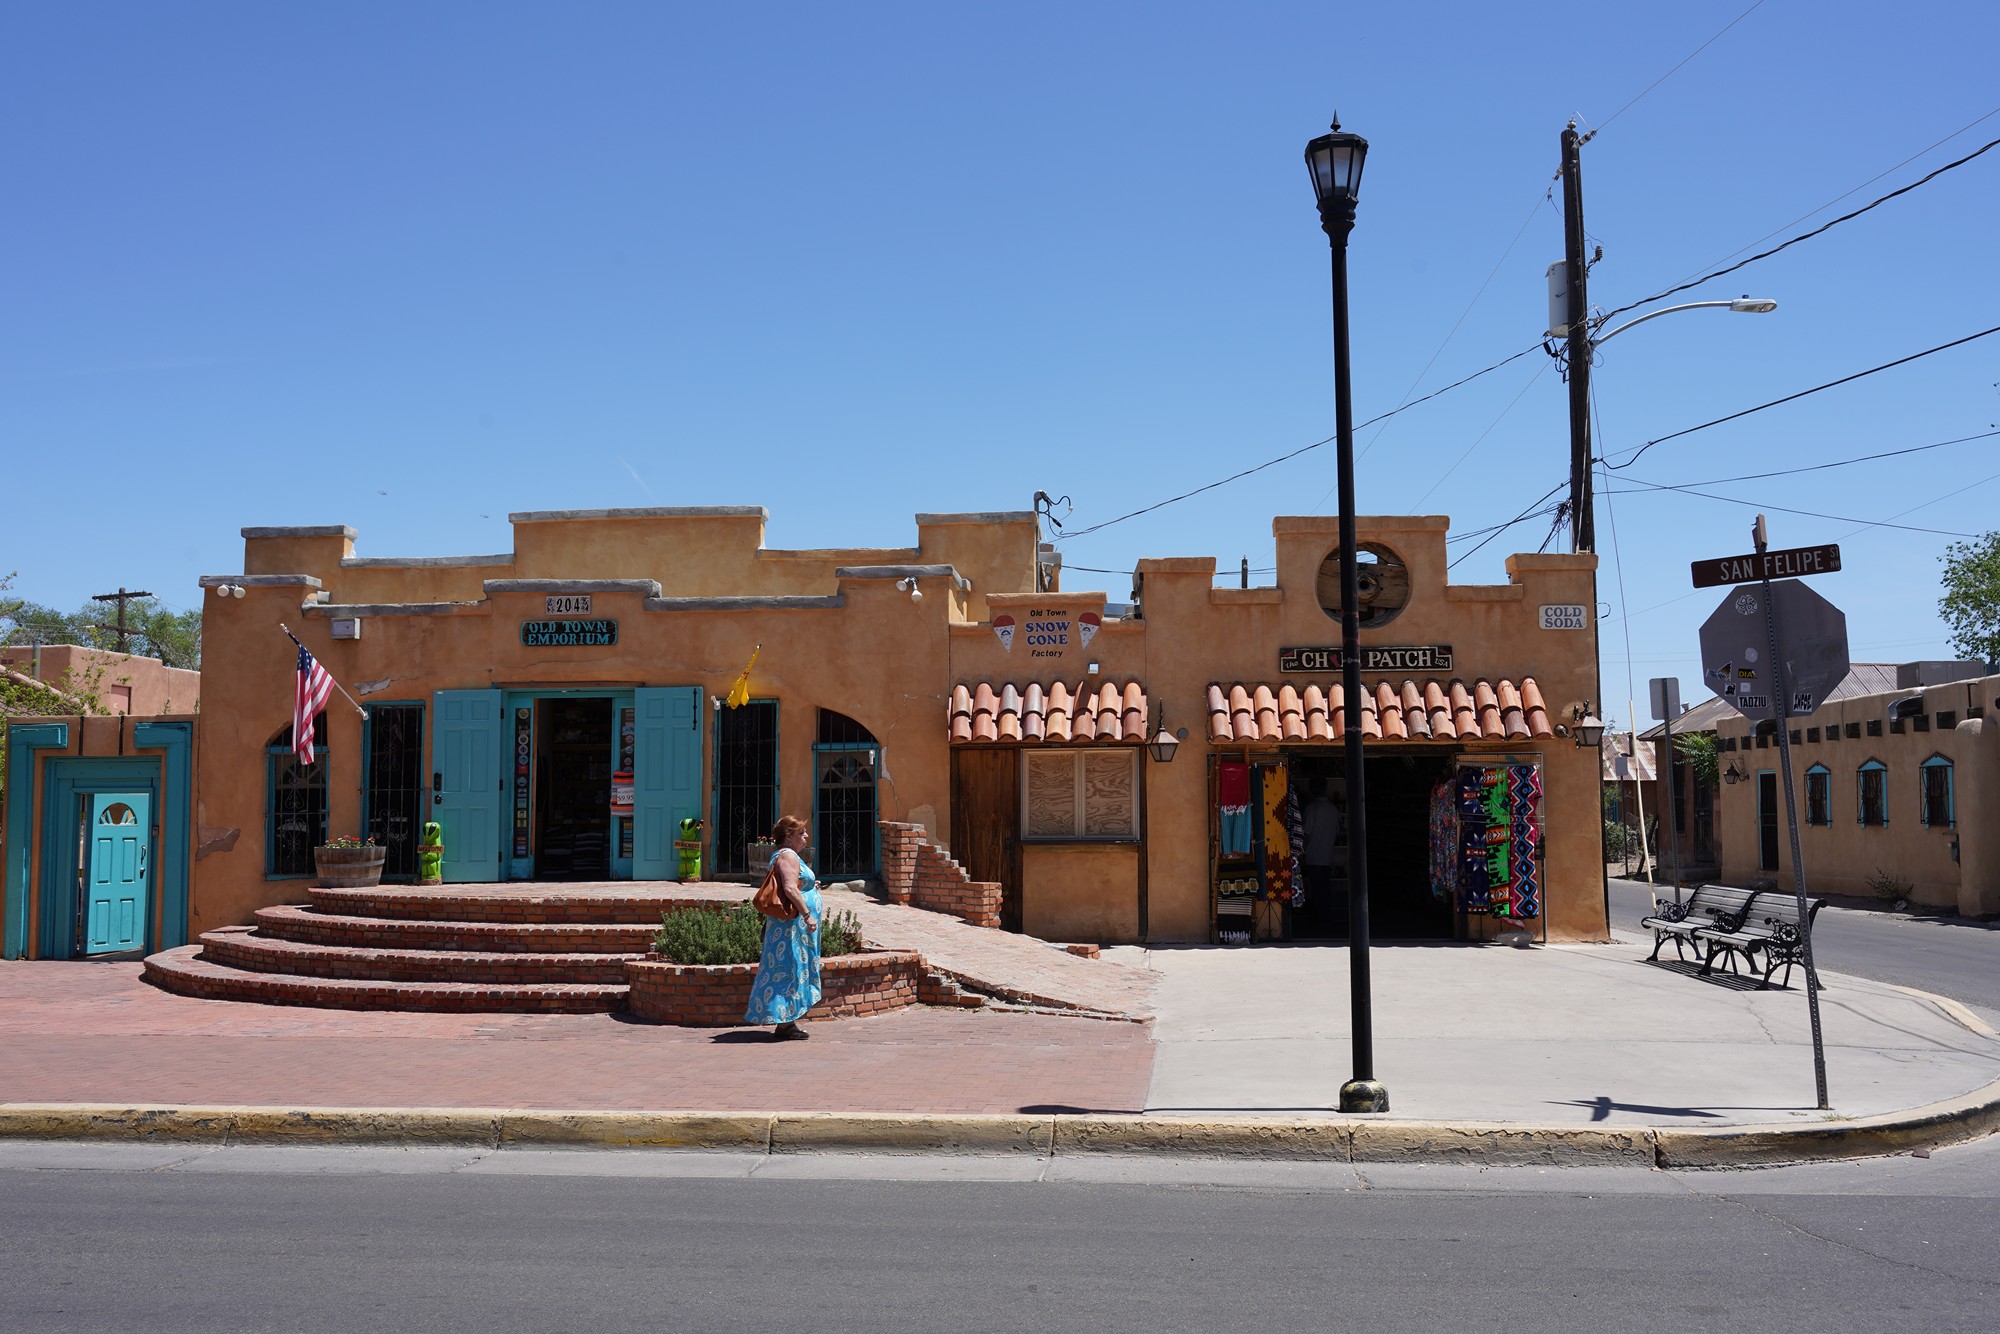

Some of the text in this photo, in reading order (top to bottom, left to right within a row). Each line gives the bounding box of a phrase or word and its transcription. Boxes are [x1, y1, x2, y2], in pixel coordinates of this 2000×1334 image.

[1720, 546, 1840, 581] SAN FELIPE ST
[1830, 560, 1840, 569] NW
[556, 598, 580, 612] 204
[1030, 609, 1067, 617] Old Town
[1544, 607, 1582, 617] COLD
[528, 621, 607, 633] OLD TOWN
[1025, 621, 1071, 633] SNOW
[1544, 618, 1583, 628] SODA
[527, 633, 610, 645] EMPORIUM
[1026, 634, 1068, 645] CONE
[1031, 649, 1063, 658] Factory
[1367, 650, 1432, 668] PATCH
[1738, 670, 1758, 678] DIA
